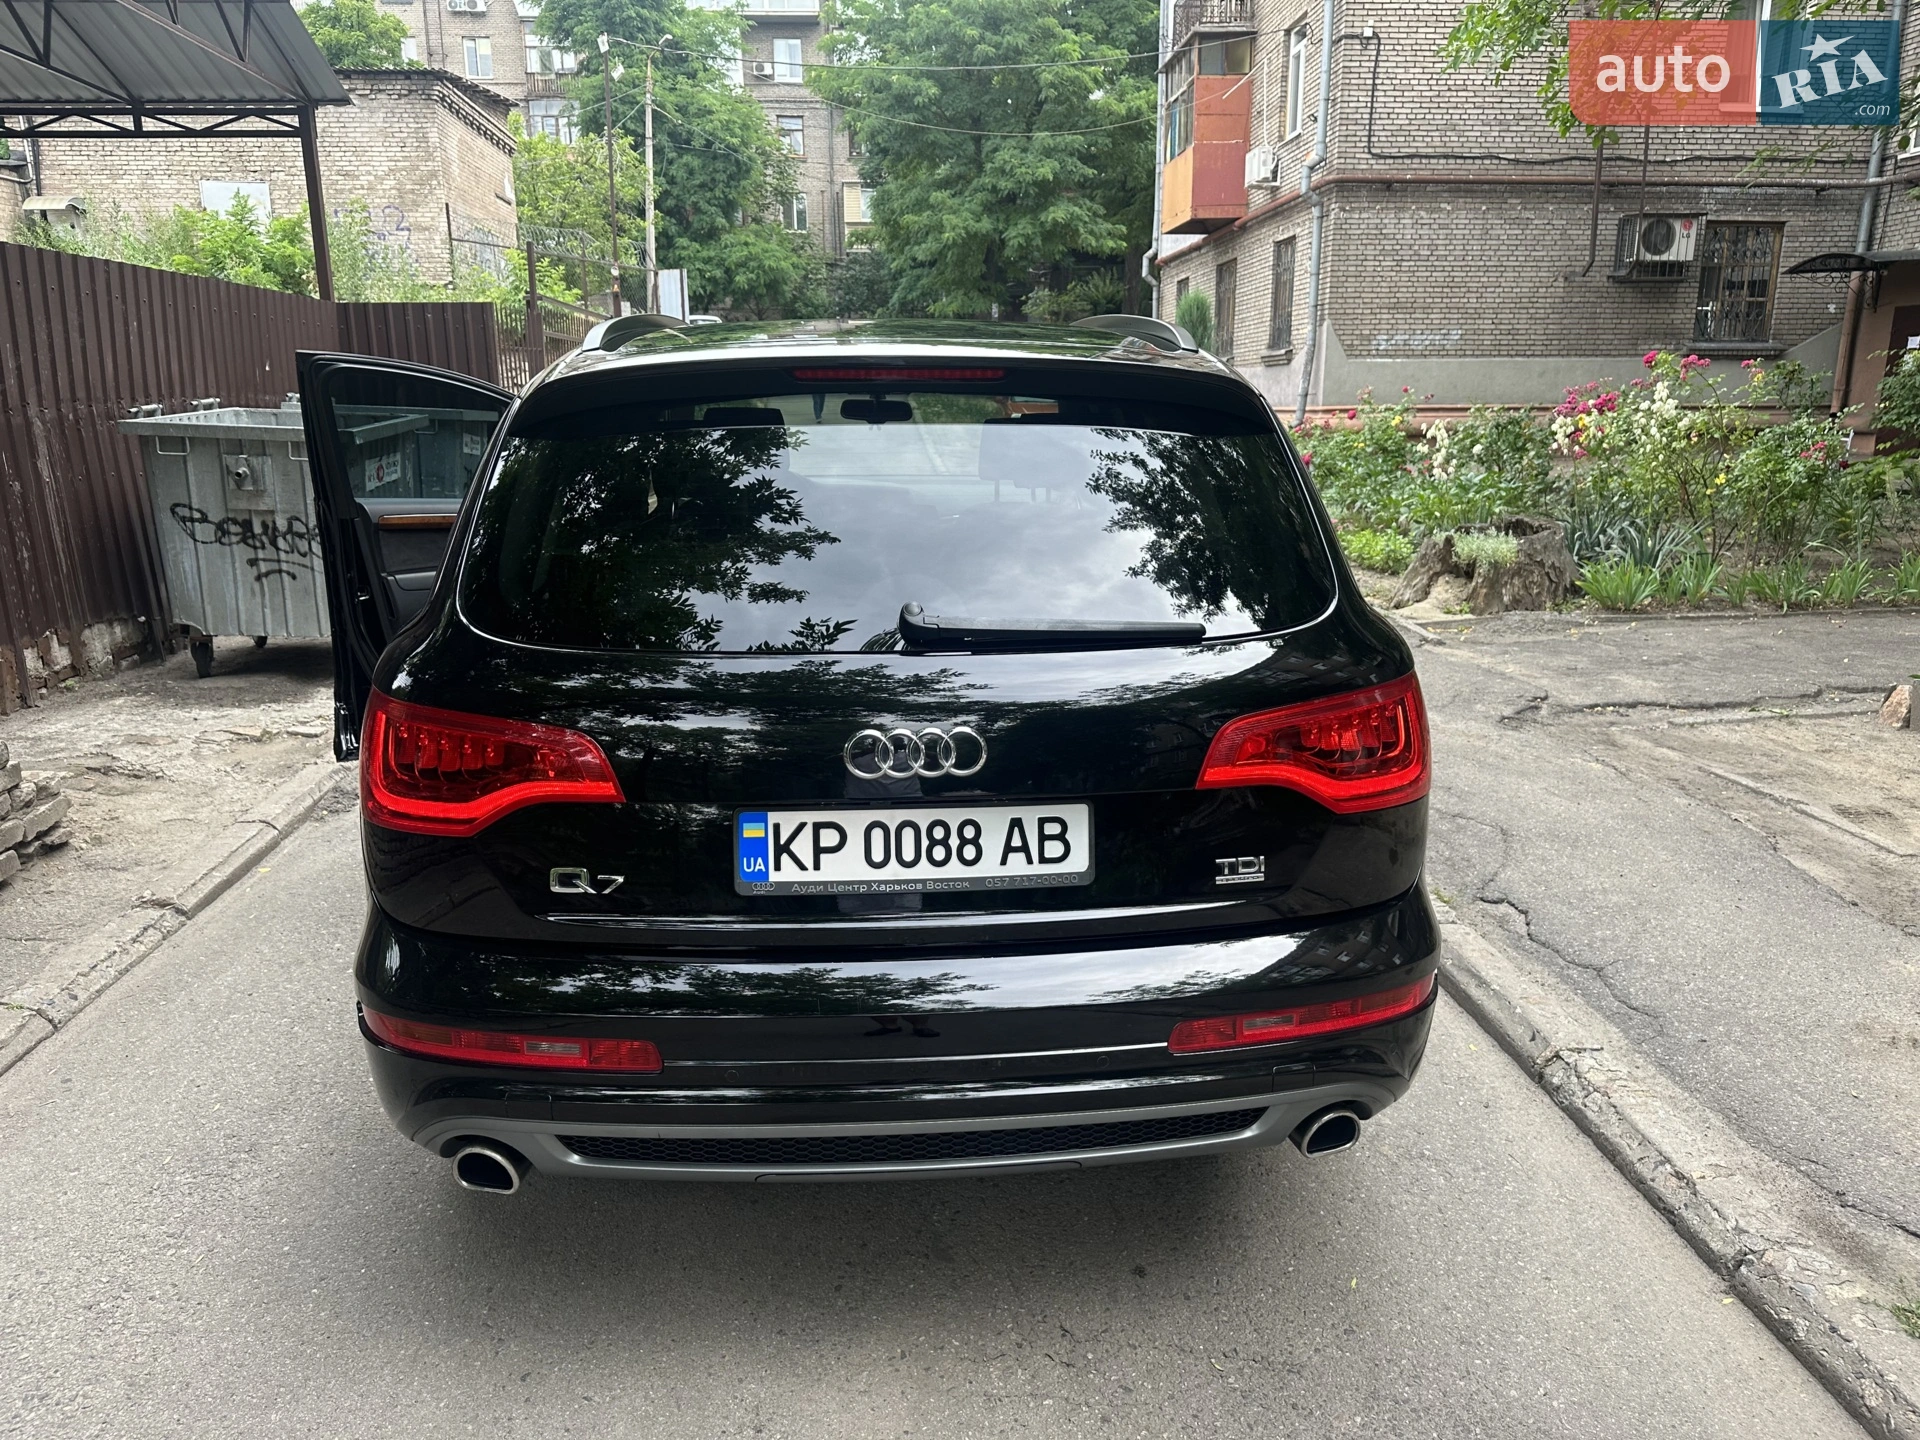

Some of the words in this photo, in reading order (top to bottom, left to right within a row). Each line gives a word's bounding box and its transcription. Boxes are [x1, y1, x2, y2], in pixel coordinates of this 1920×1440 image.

[772, 820, 848, 872] KP
[863, 817, 984, 870] 0088
[999, 815, 1072, 865] AB
[743, 856, 766, 873] UA
[1215, 855, 1265, 875] TDI
[549, 867, 625, 894] Q7
[791, 883, 824, 894] Ауди
[827, 882, 868, 893] Центр
[870, 881, 923, 892] Харьков
[926, 880, 970, 890] Восток
[985, 877, 1010, 888] 057
[1013, 874, 1079, 886] 717-00-00
